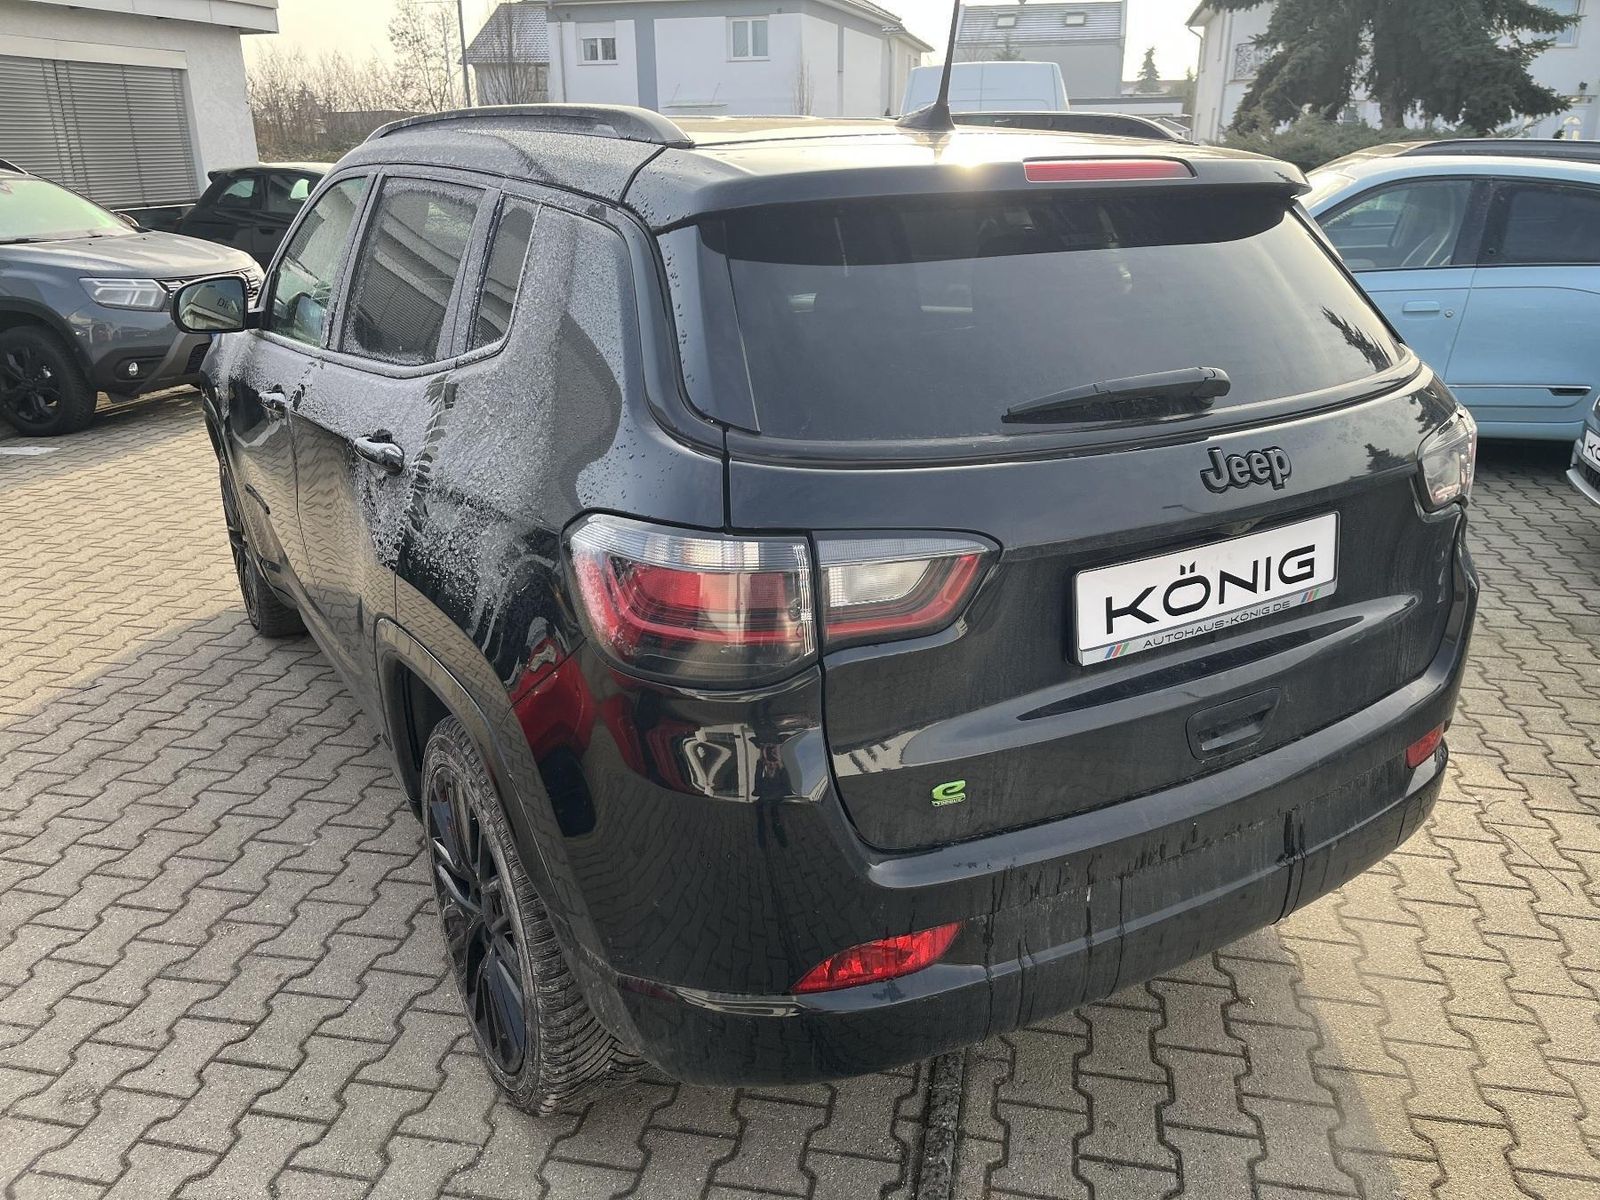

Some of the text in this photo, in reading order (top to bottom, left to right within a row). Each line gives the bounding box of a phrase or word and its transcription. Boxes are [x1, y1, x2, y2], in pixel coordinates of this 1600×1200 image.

[1201, 446, 1292, 493] Jeep
[1105, 544, 1316, 635] KÖNIG
[1143, 600, 1291, 649] AUTOHAUS-KÖNIG.DE
